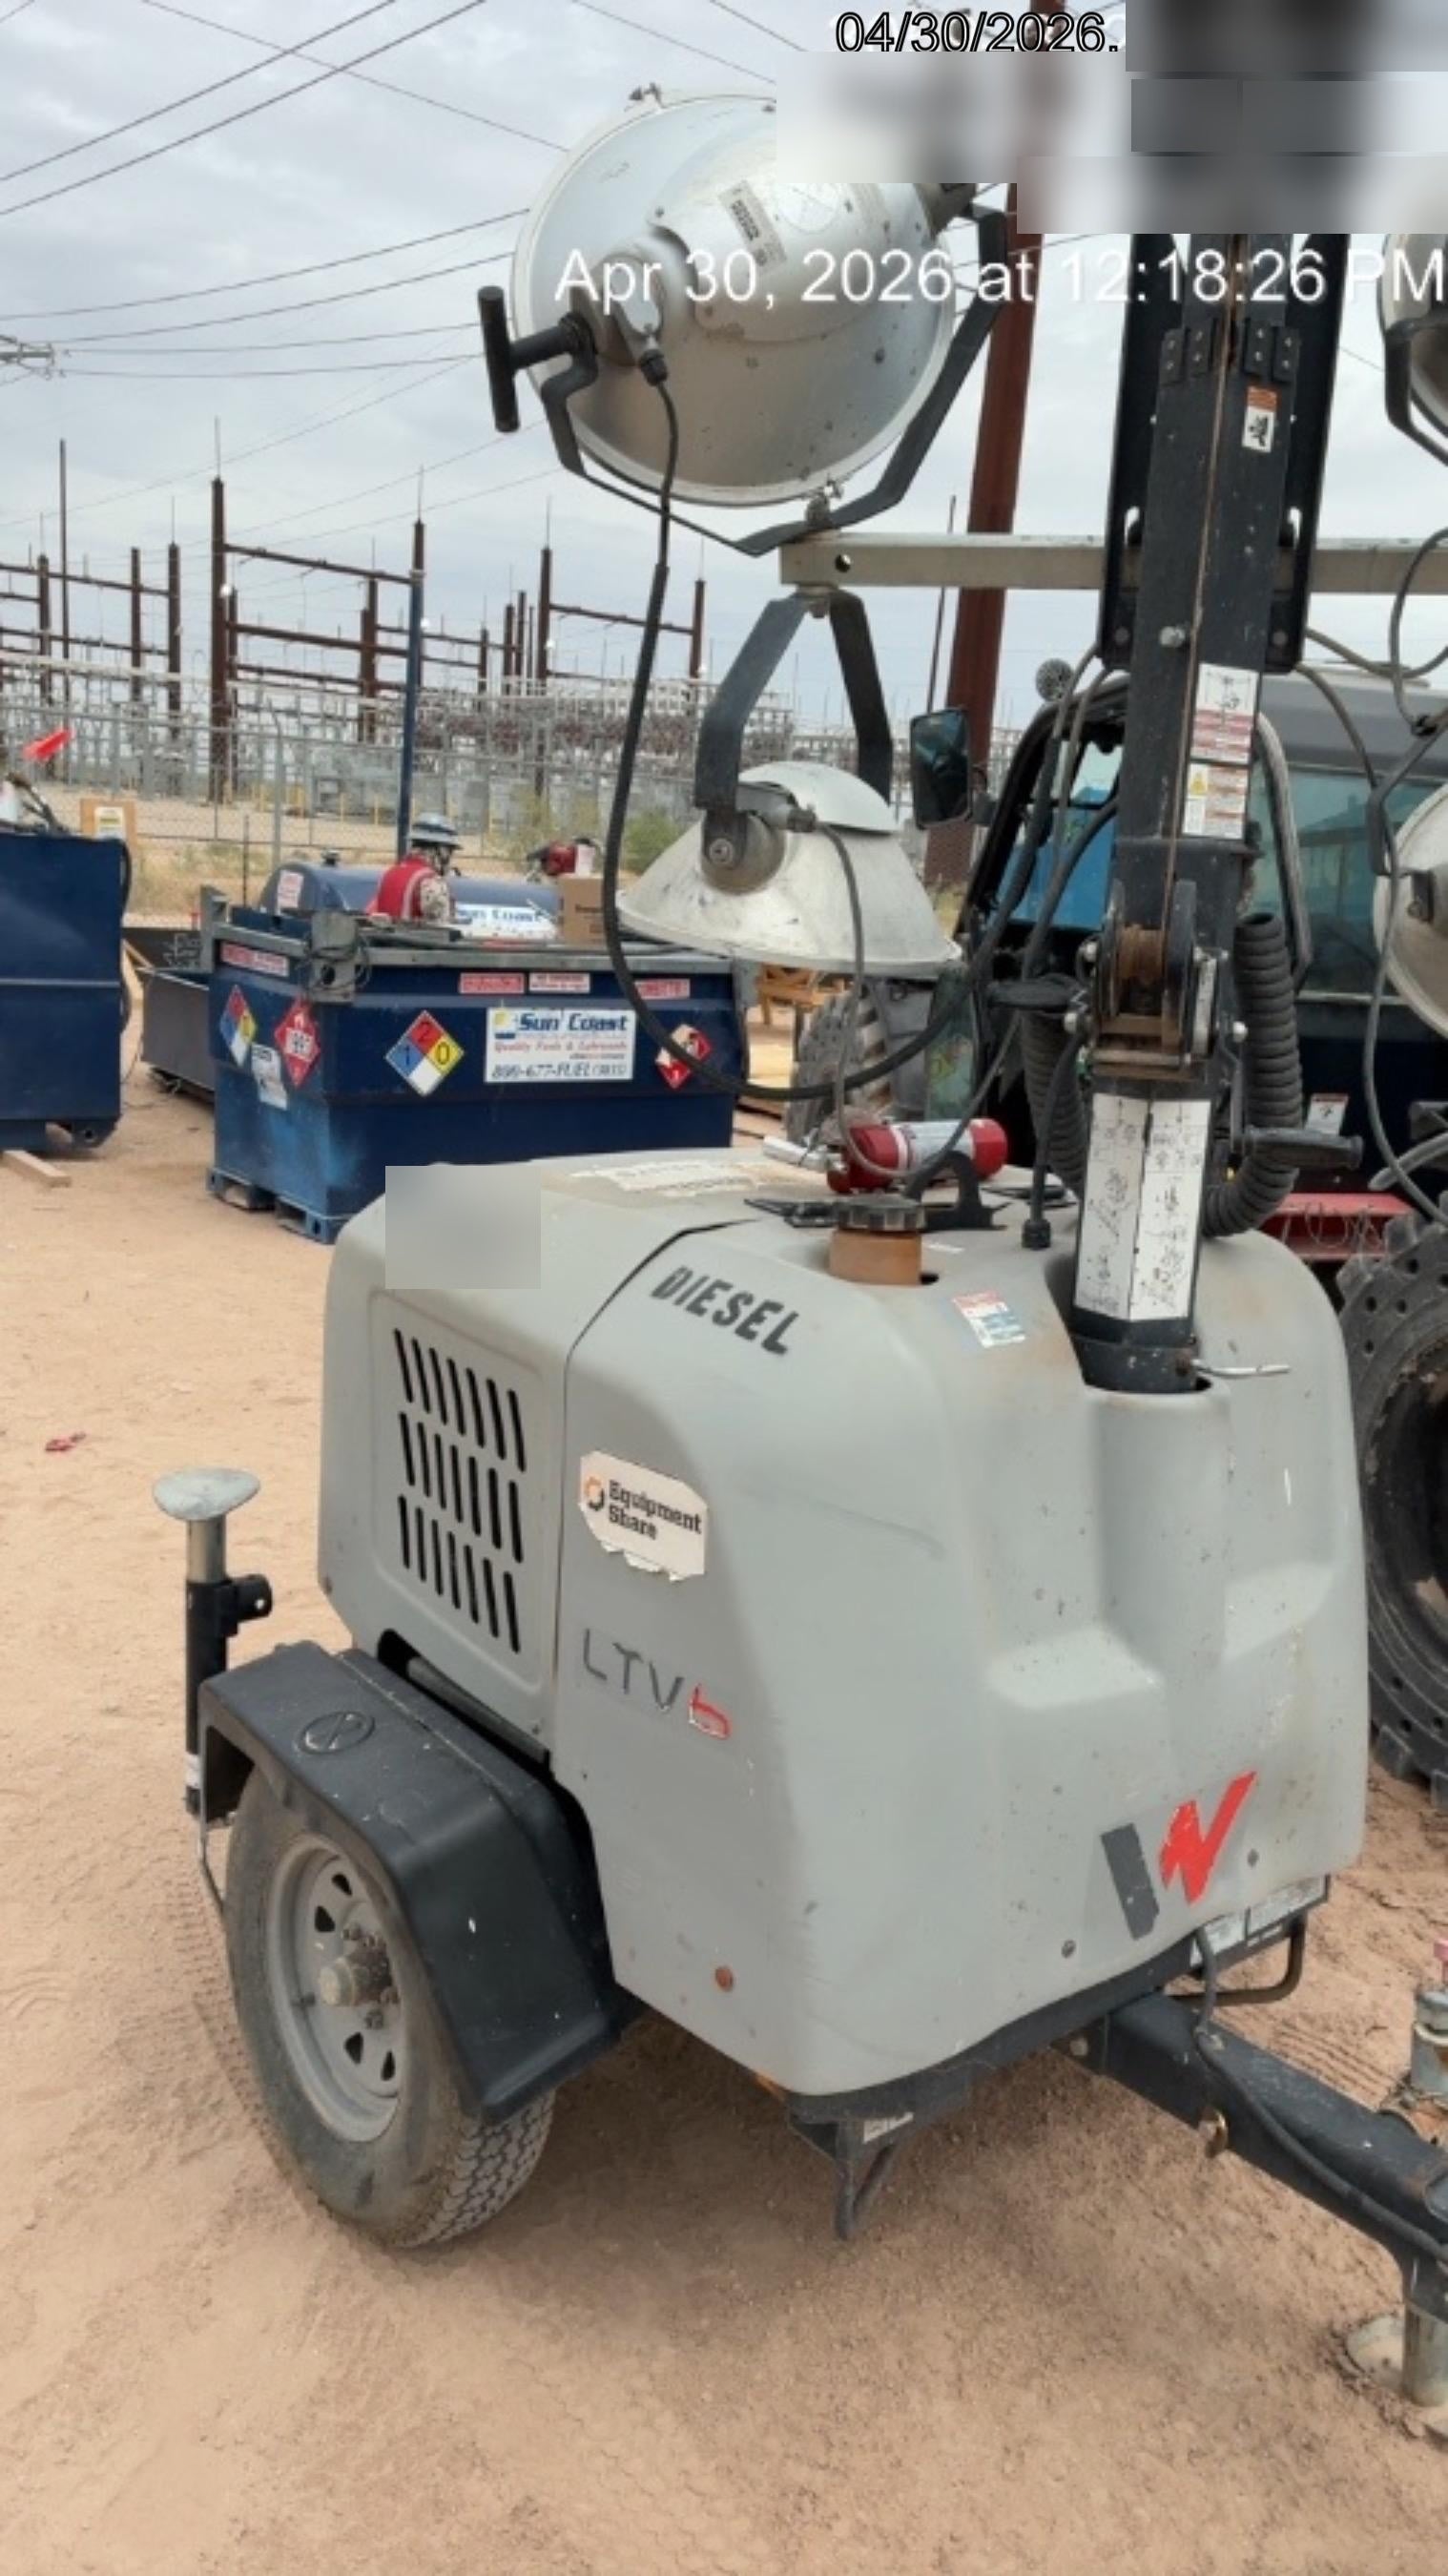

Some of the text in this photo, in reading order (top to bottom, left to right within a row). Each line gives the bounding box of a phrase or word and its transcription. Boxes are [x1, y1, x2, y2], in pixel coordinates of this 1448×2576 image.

[418, 1022, 429, 1043] 2
[518, 1012, 627, 1030] Sun Coast
[436, 1042, 449, 1066] 0
[651, 1266, 799, 1355] DIESEL
[609, 1479, 702, 1535] Equipment
[609, 1504, 657, 1540] Share
